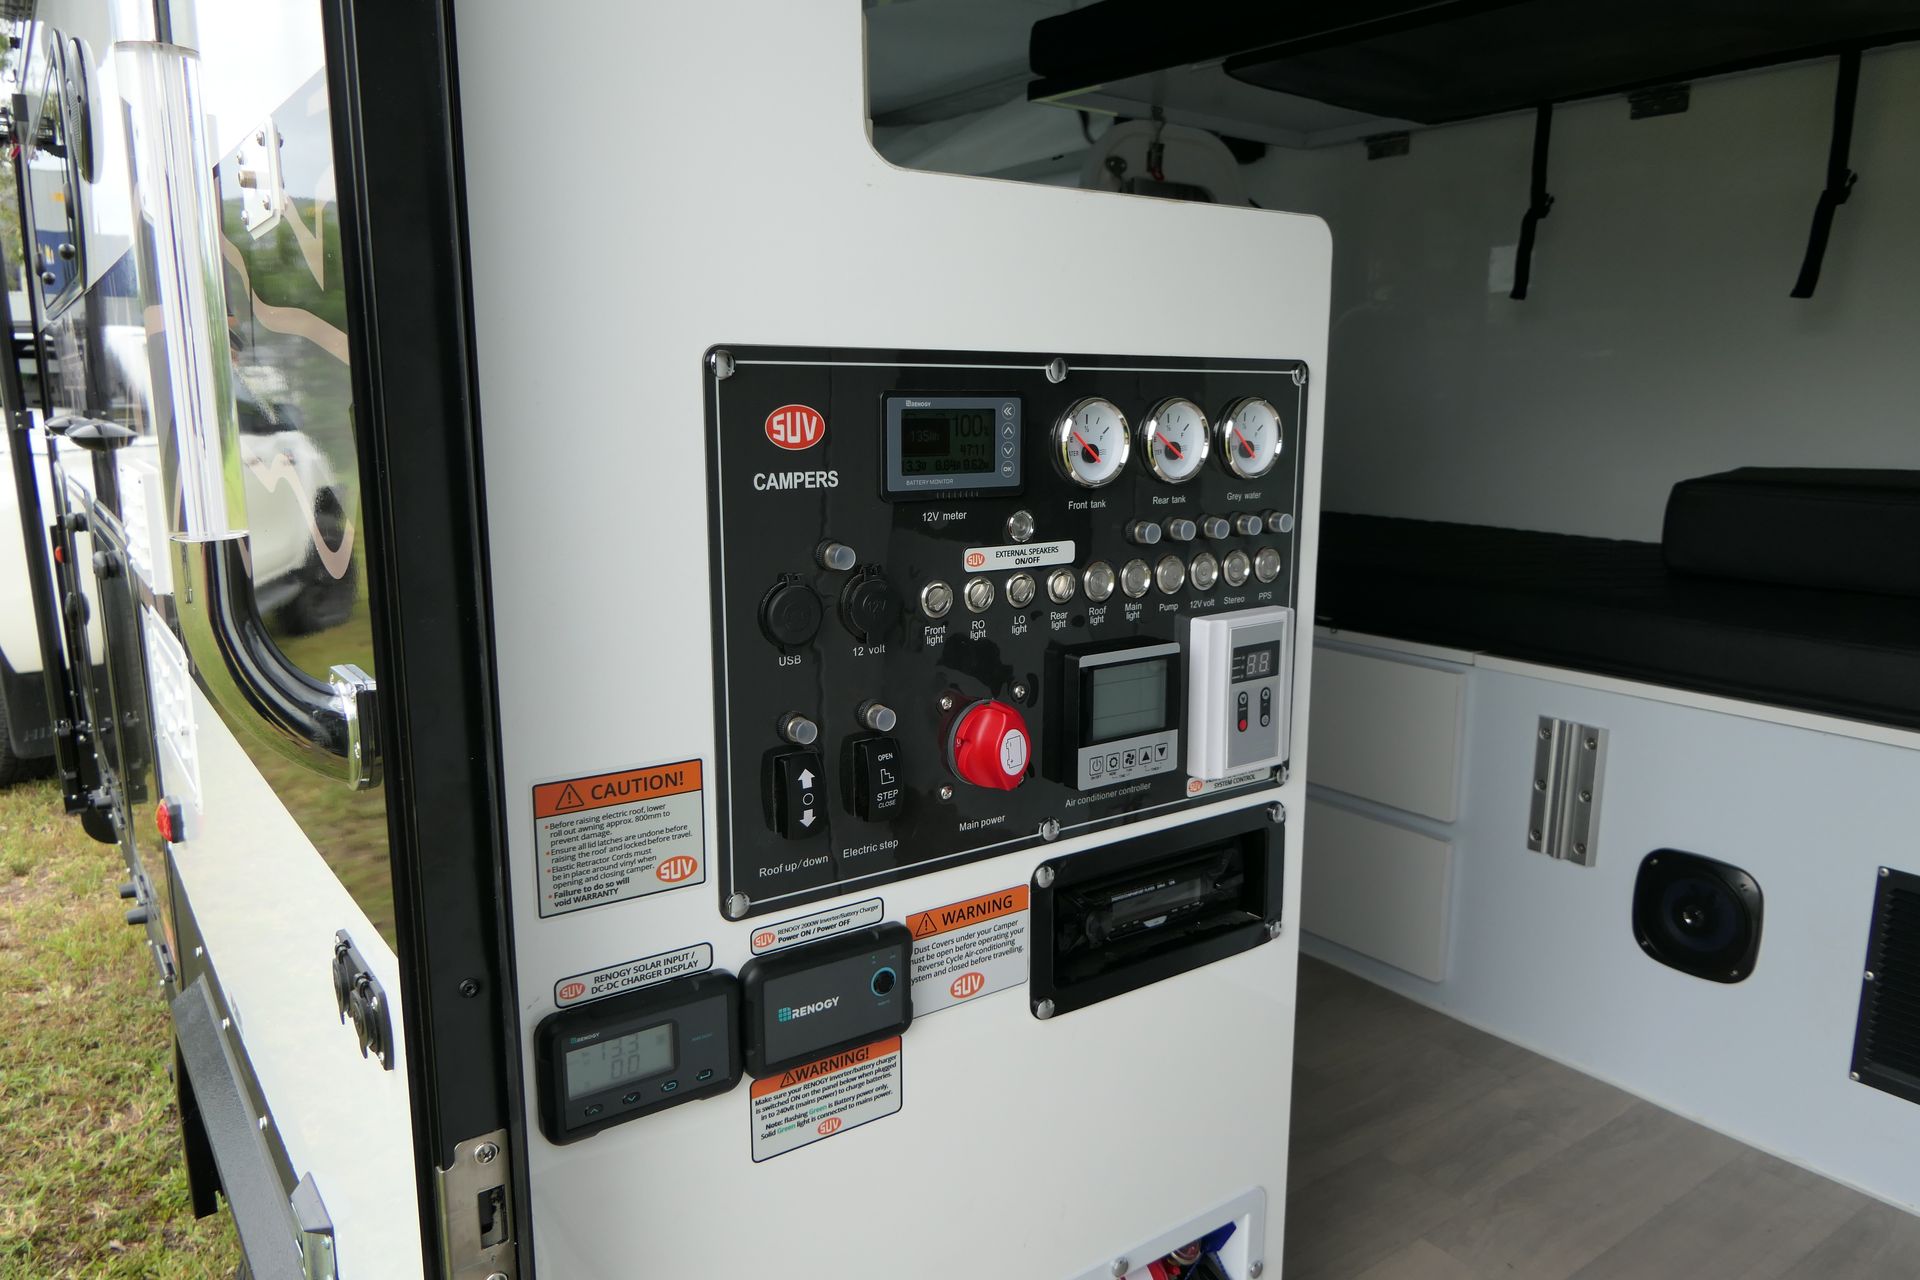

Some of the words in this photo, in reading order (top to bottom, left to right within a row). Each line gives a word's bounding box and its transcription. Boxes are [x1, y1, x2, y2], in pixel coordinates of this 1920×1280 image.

[773, 411, 817, 443] SUV
[753, 470, 839, 491] CAMPERS
[1152, 496, 1169, 505] Rear
[1170, 494, 1186, 504] tank
[1226, 492, 1243, 502] Grey
[1244, 490, 1261, 500] water
[1068, 500, 1086, 510] Front
[1087, 499, 1107, 510] tank
[922, 512, 939, 522] 12V
[942, 511, 967, 521] meter
[995, 546, 1026, 559] EXTERNAL
[1027, 545, 1059, 557] SPEAKERS
[967, 554, 985, 567] SUV
[1014, 556, 1041, 567] ON/OFF
[1190, 598, 1203, 608] 12V
[1203, 597, 1215, 607] volt
[1223, 595, 1245, 605] Stereo
[1258, 591, 1272, 601] PPS
[1088, 606, 1107, 618] Roof
[1124, 602, 1143, 613] Main
[1159, 602, 1179, 615] Pump
[1013, 615, 1026, 626] LO
[1050, 611, 1069, 622] Rear
[1089, 613, 1105, 626] light
[1125, 609, 1141, 622] light
[924, 625, 946, 637] Front
[971, 620, 986, 630] RO
[1011, 622, 1028, 636] light
[1051, 618, 1067, 630] light
[926, 633, 944, 647] light
[970, 628, 987, 641] light
[853, 647, 864, 657] 12
[868, 644, 886, 655] volt
[778, 655, 802, 667] USB
[878, 753, 893, 762] OPEN
[591, 771, 684, 800] CAUTION!
[876, 789, 899, 802] STEP
[1065, 797, 1077, 808] Air
[1077, 789, 1118, 806] conditioner
[1118, 781, 1152, 797] controller
[878, 800, 896, 809] CLOSE
[550, 820, 574, 831] Before
[576, 814, 600, 825] raising
[602, 810, 628, 820] electric
[629, 806, 646, 816] roof,
[646, 804, 666, 813] lower
[959, 820, 980, 832] Main
[981, 814, 1006, 830] power
[550, 829, 563, 838] roll
[578, 822, 605, 833] awning
[635, 813, 662, 822] 800mm
[551, 835, 579, 847] prevent
[580, 830, 613, 841] damage.
[551, 846, 577, 856] Ensure
[578, 842, 587, 851] all
[597, 836, 623, 847] latches
[624, 834, 637, 842] are
[637, 829, 665, 839] undone
[665, 824, 688, 834] before
[551, 854, 577, 864] raising
[578, 850, 591, 859] the
[591, 846, 607, 856] roof
[609, 843, 623, 852] and
[623, 840, 647, 850] locked
[647, 835, 671, 845] before
[671, 830, 693, 840] travel.
[843, 843, 878, 859] Electric
[879, 839, 899, 852] step
[551, 862, 575, 873] Elastic
[576, 855, 610, 868] Retractor
[611, 851, 633, 861] Cords
[634, 848, 652, 857] must
[552, 873, 562, 881] be
[563, 871, 570, 879] in
[571, 867, 591, 878] place
[592, 862, 619, 873] around
[619, 858, 637, 868] vinyl
[637, 855, 657, 864] when
[759, 864, 783, 877] Roof
[784, 855, 829, 873] up/down
[553, 879, 584, 890] opening
[600, 867, 625, 878] closing
[626, 863, 655, 874] camper.
[660, 859, 693, 880] SUV
[554, 889, 582, 900] Failure
[593, 882, 604, 890] do
[616, 877, 630, 886] will
[554, 898, 572, 907] void
[573, 887, 619, 903] WARRANTY
[942, 895, 1013, 926] WARNING
[778, 932, 799, 944] Power
[800, 929, 812, 938] ON
[816, 922, 838, 933] Power
[838, 918, 852, 927] OFF
[914, 945, 930, 955] Dust
[931, 938, 955, 949] Covers
[955, 932, 976, 943] under
[977, 927, 992, 939] your
[993, 920, 1018, 932] Camper
[755, 934, 775, 947] SUV
[911, 955, 925, 965] ust
[926, 953, 935, 961] be
[936, 948, 954, 958] open
[955, 940, 977, 952] before
[978, 931, 1009, 946] operating
[1010, 927, 1025, 938] your
[594, 966, 631, 985] RENOGY
[633, 959, 662, 976] SOLAR
[663, 953, 689, 968] INPUT
[917, 960, 944, 973] Reverse
[945, 954, 963, 965] Cycle
[933, 967, 947, 977] and
[948, 960, 970, 973] closed
[970, 955, 992, 966] before
[591, 980, 620, 995] DC-DC
[621, 969, 663, 987] CHARGER
[664, 959, 699, 975] DISPLAY
[562, 983, 585, 998] SUV
[954, 975, 981, 996] SUV
[792, 996, 839, 1019] RENOGY
[795, 1047, 869, 1081] WARNING!
[820, 1118, 840, 1133] SUV
